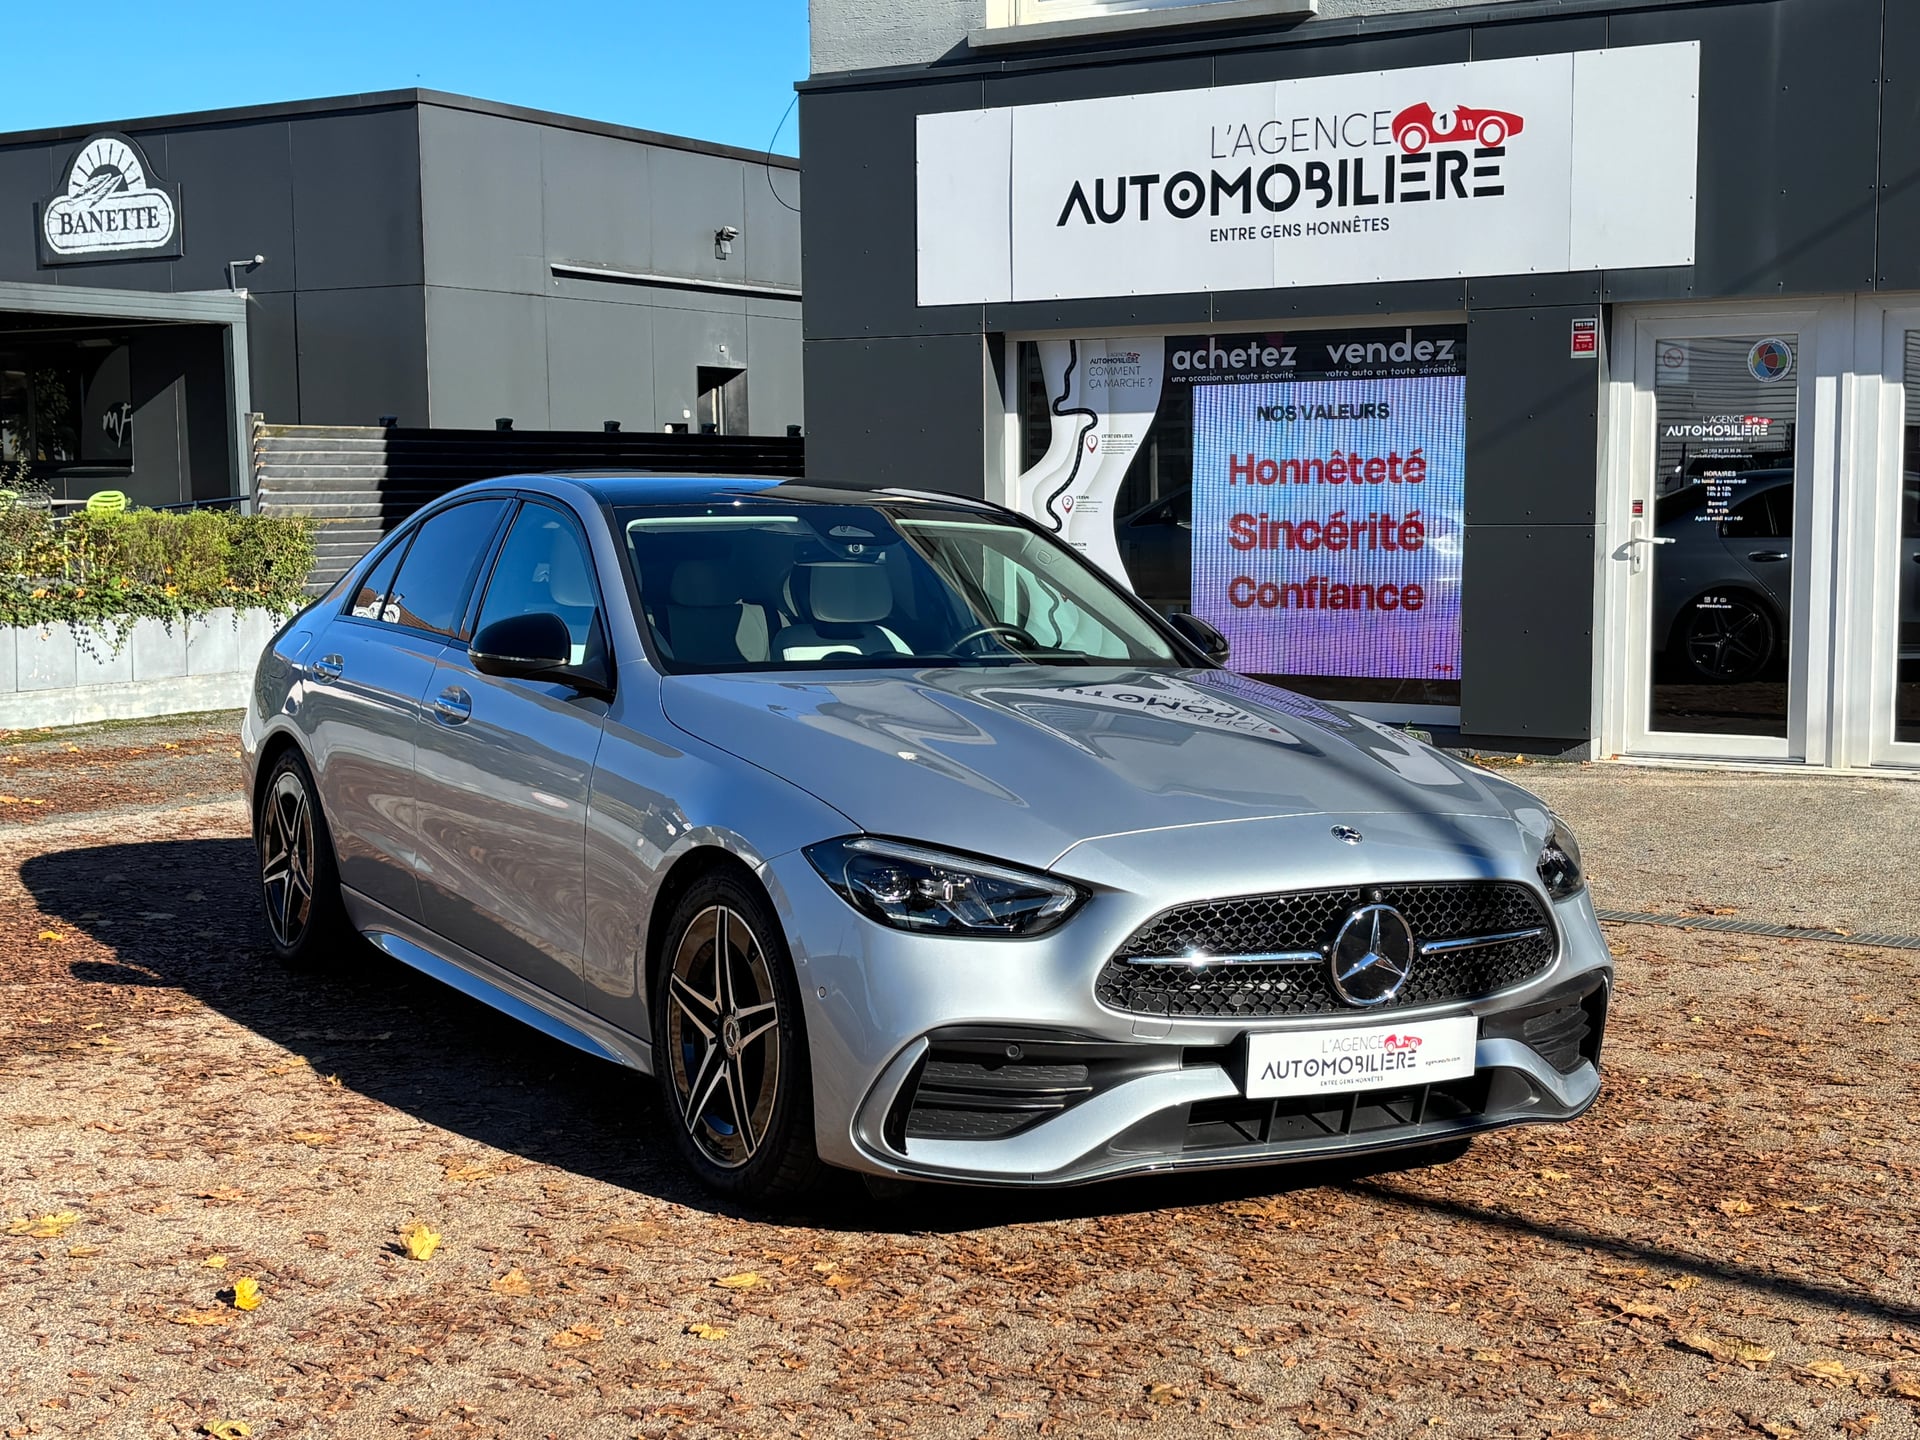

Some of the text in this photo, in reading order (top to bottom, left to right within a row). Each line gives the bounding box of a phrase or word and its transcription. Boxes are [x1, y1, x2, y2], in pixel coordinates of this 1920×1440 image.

[1210, 110, 1393, 159] L'AGENCE
[59, 206, 161, 236] BANETTE
[1210, 215, 1391, 243] ENTRE GENS HONNÊTES
[1171, 337, 1297, 370] achetez
[1326, 328, 1456, 365] vendez
[1088, 365, 1141, 376] COMMENT
[1088, 377, 1153, 390] ÇA MARCHE ?
[1188, 373, 1222, 382] occasion
[1224, 374, 1235, 382] en
[1236, 373, 1259, 381] toute
[1351, 368, 1373, 376] auto
[1390, 367, 1416, 375] toute
[1256, 403, 1390, 422] NOS VALEURS
[1228, 447, 1427, 486] Honnêteté
[1228, 510, 1425, 551] Sincérité
[1227, 576, 1424, 611] Confiance
[1321, 1035, 1385, 1054] L'AGENCE
[1261, 1050, 1417, 1080] AUTOMOBILIERE
